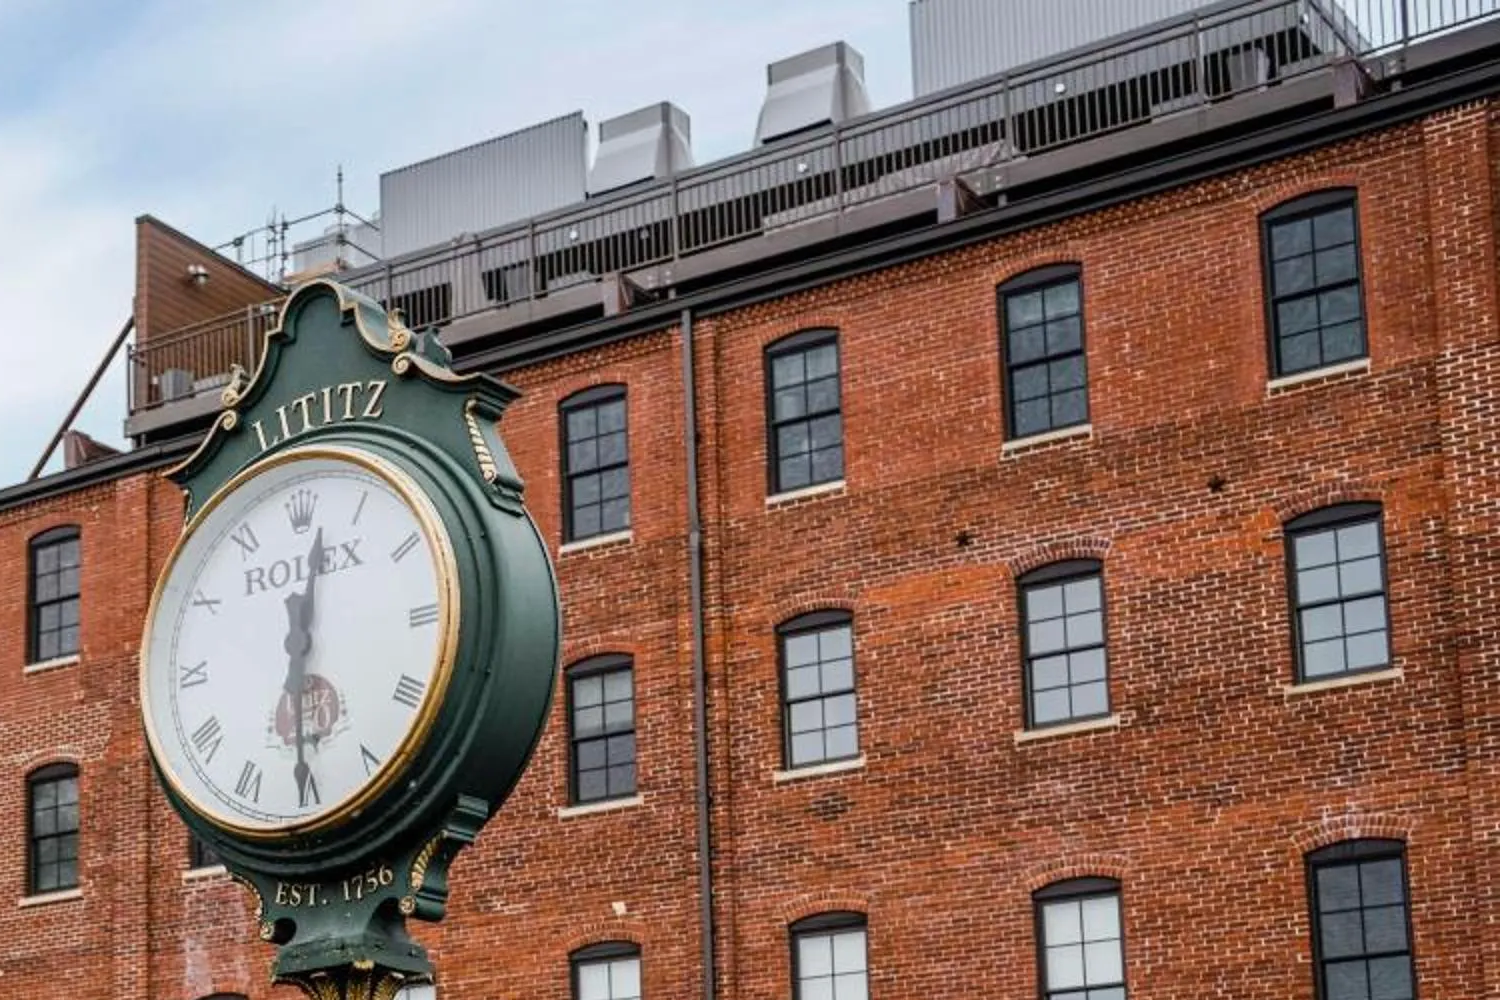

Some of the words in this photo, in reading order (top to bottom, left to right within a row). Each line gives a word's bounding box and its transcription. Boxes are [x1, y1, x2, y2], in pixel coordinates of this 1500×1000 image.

[252, 380, 388, 451] LITITZ
[244, 537, 365, 596] ROLEX
[275, 881, 328, 907] EST.
[342, 863, 394, 901] 1756
